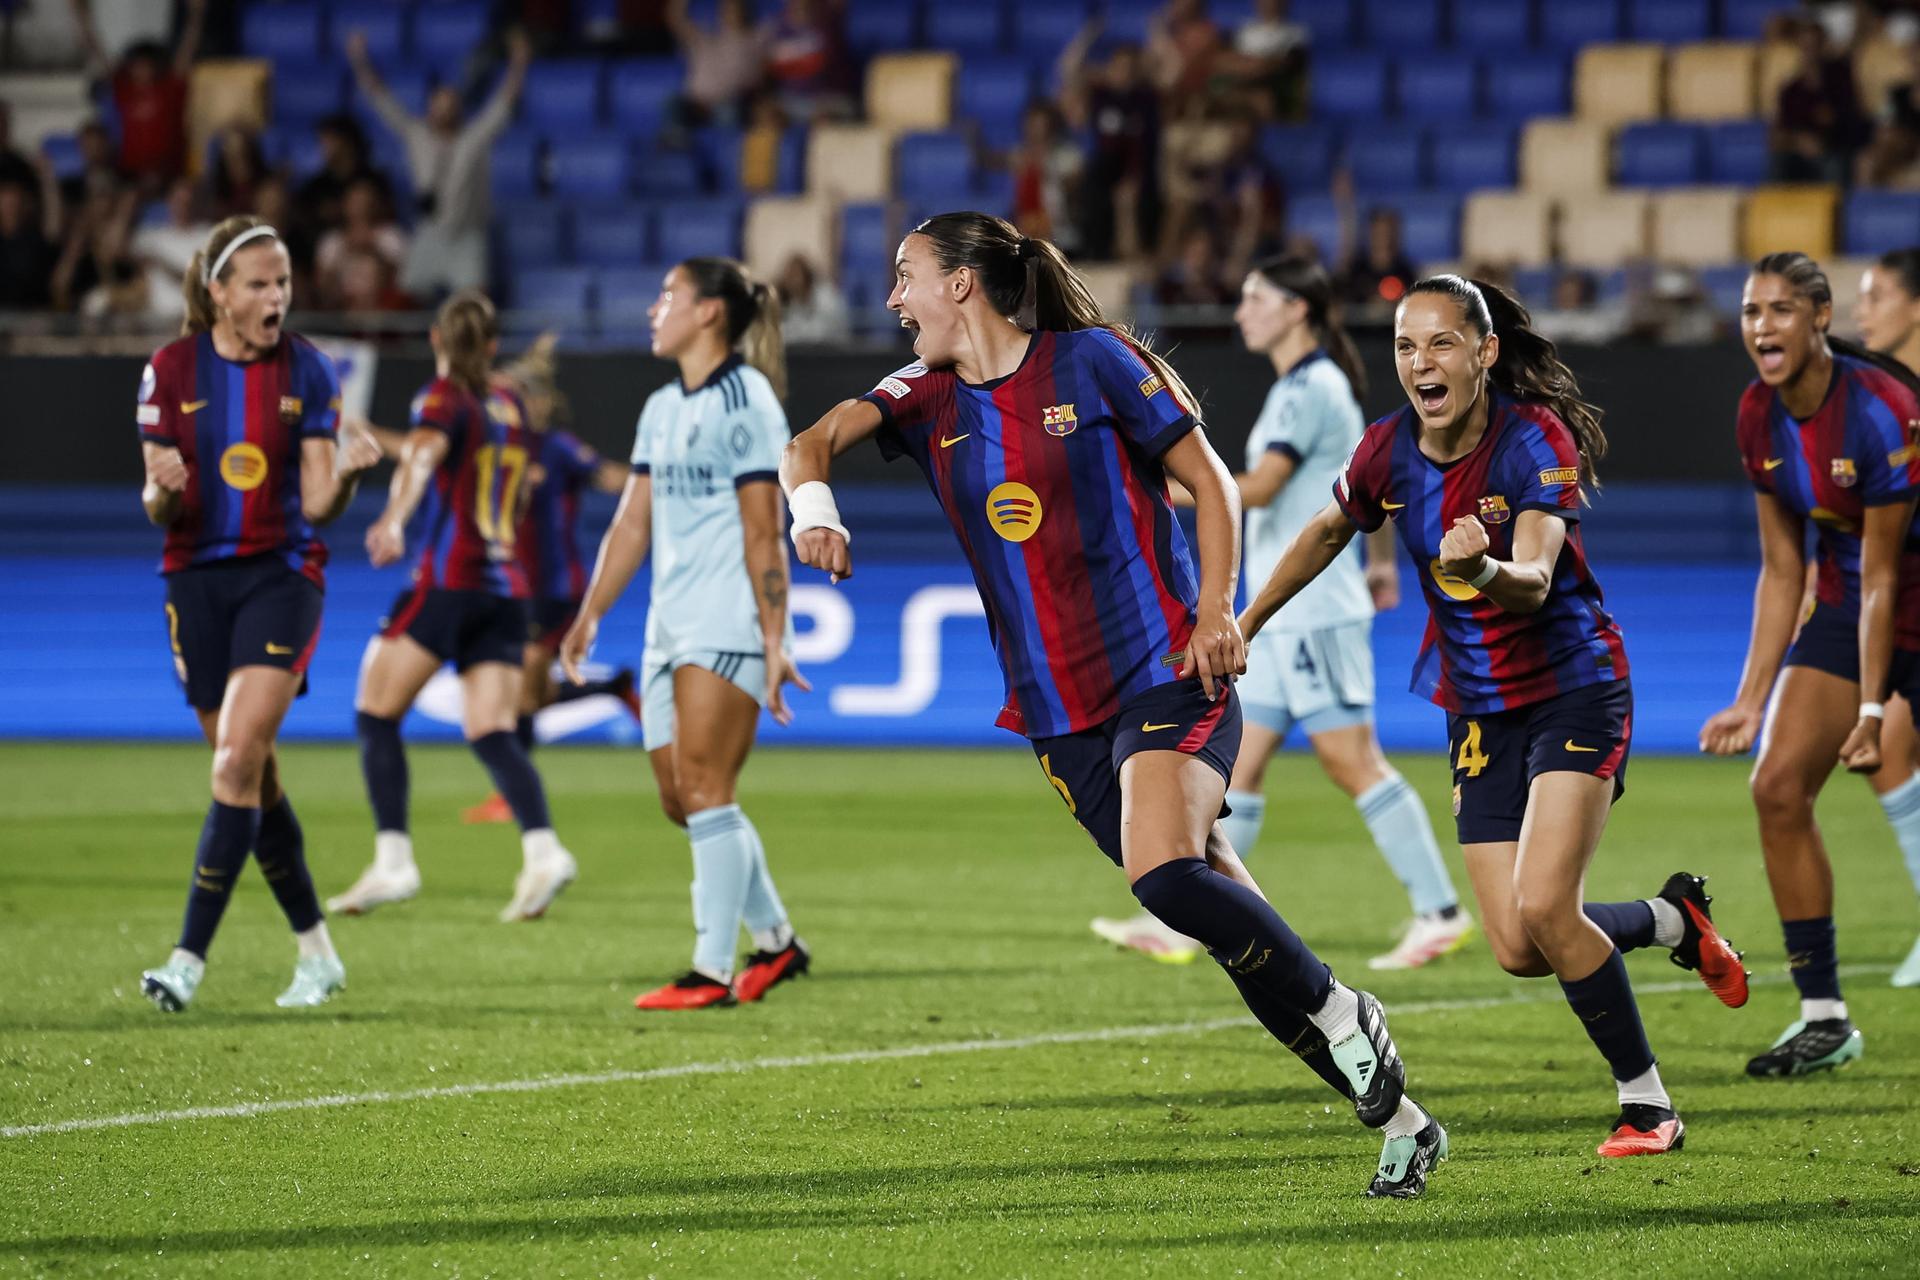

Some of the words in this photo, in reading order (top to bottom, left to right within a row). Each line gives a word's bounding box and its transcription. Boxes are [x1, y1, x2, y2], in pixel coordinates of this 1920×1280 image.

[475, 446, 527, 541] 17
[1540, 469, 1578, 484] BIMBO
[1456, 721, 1490, 777] 4
